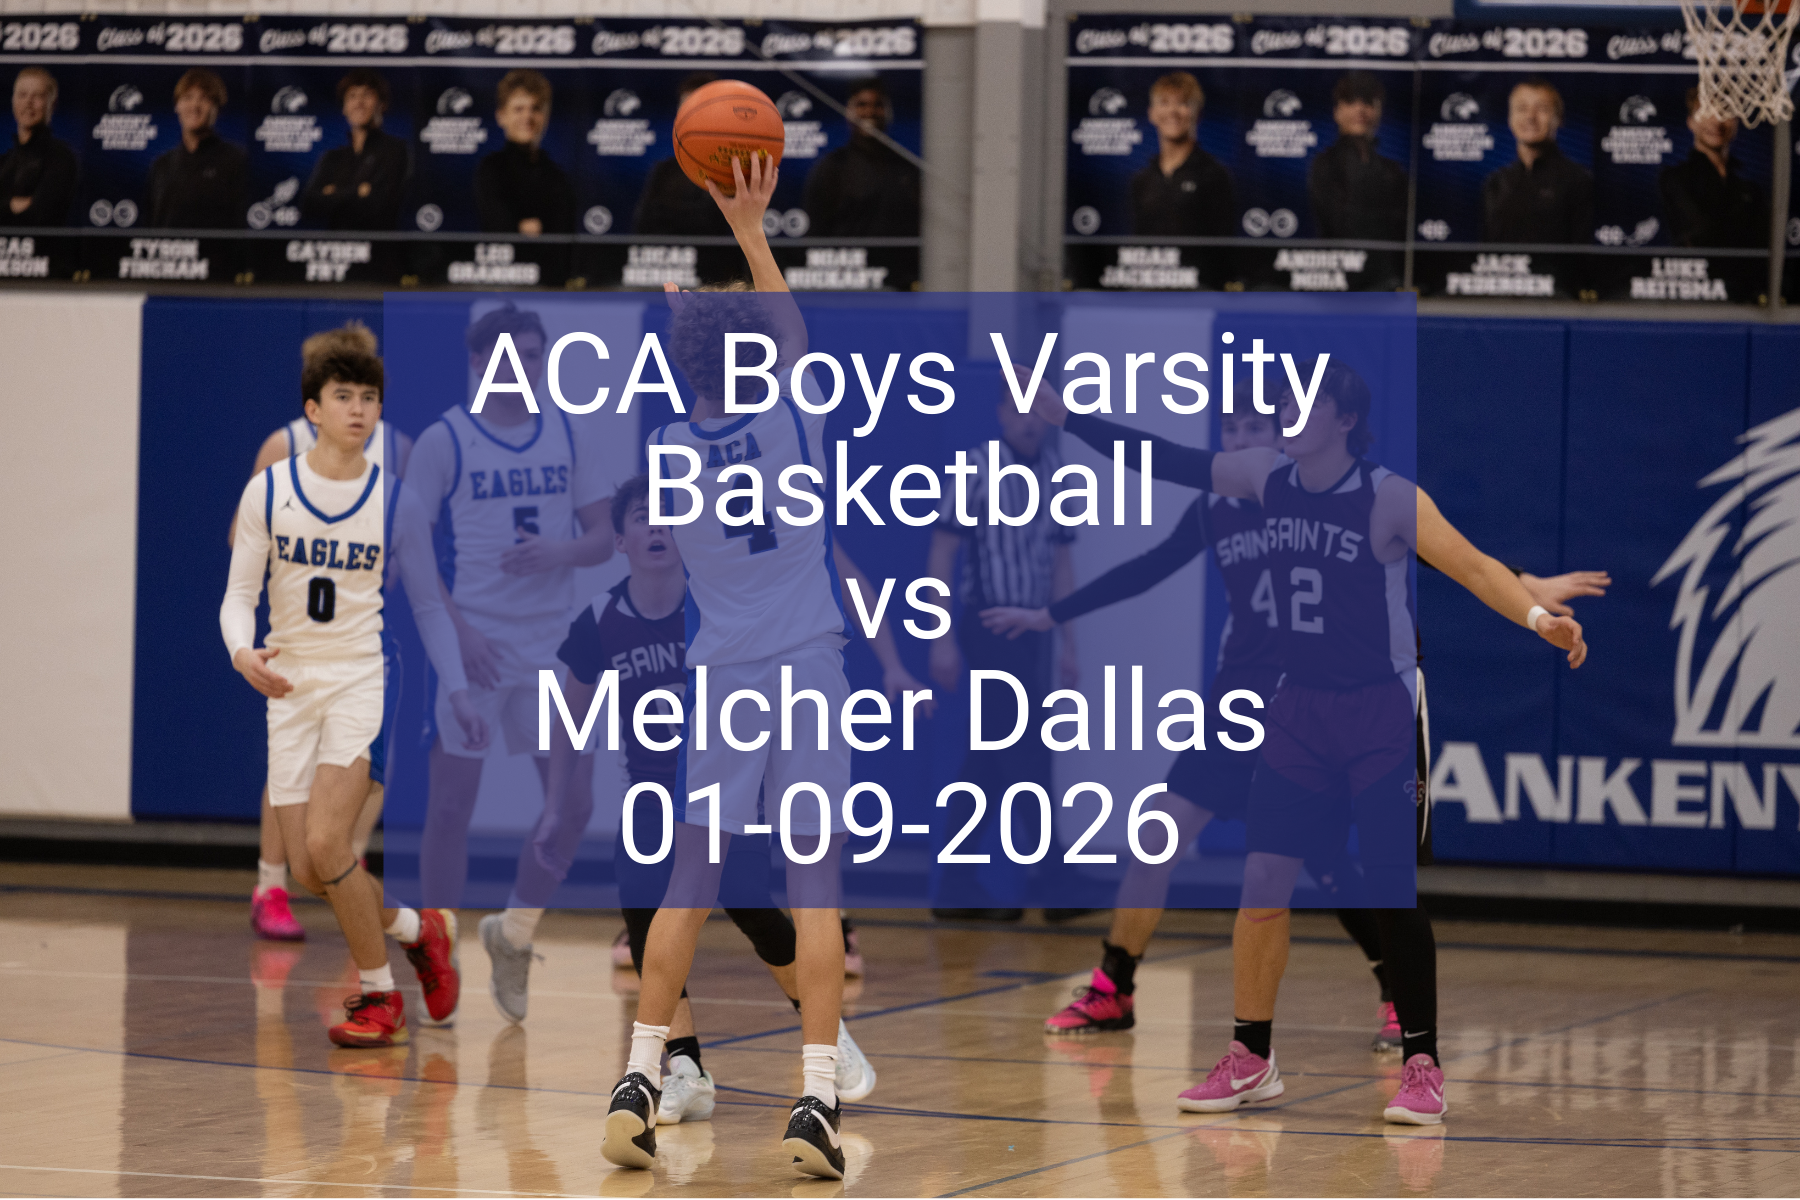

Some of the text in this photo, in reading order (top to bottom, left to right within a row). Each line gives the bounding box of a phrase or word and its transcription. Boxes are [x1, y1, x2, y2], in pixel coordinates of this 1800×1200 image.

[3, 22, 80, 51] 2026
[166, 23, 244, 52] 2026
[327, 24, 409, 53] 2026
[495, 25, 577, 54] 2026
[661, 26, 746, 56] 2026
[833, 27, 917, 57] 2026
[1149, 24, 1235, 53] 2026
[1324, 26, 1411, 56] 2026
[1502, 28, 1589, 58] 2026
[706, 431, 762, 469] ACA
[469, 464, 569, 500] EAGLES
[275, 534, 381, 572] EAGLES
[1215, 527, 1270, 568] SAIN
[1266, 516, 1365, 563] SAINTS
[307, 575, 336, 624] 0
[610, 641, 687, 681] SAIN
